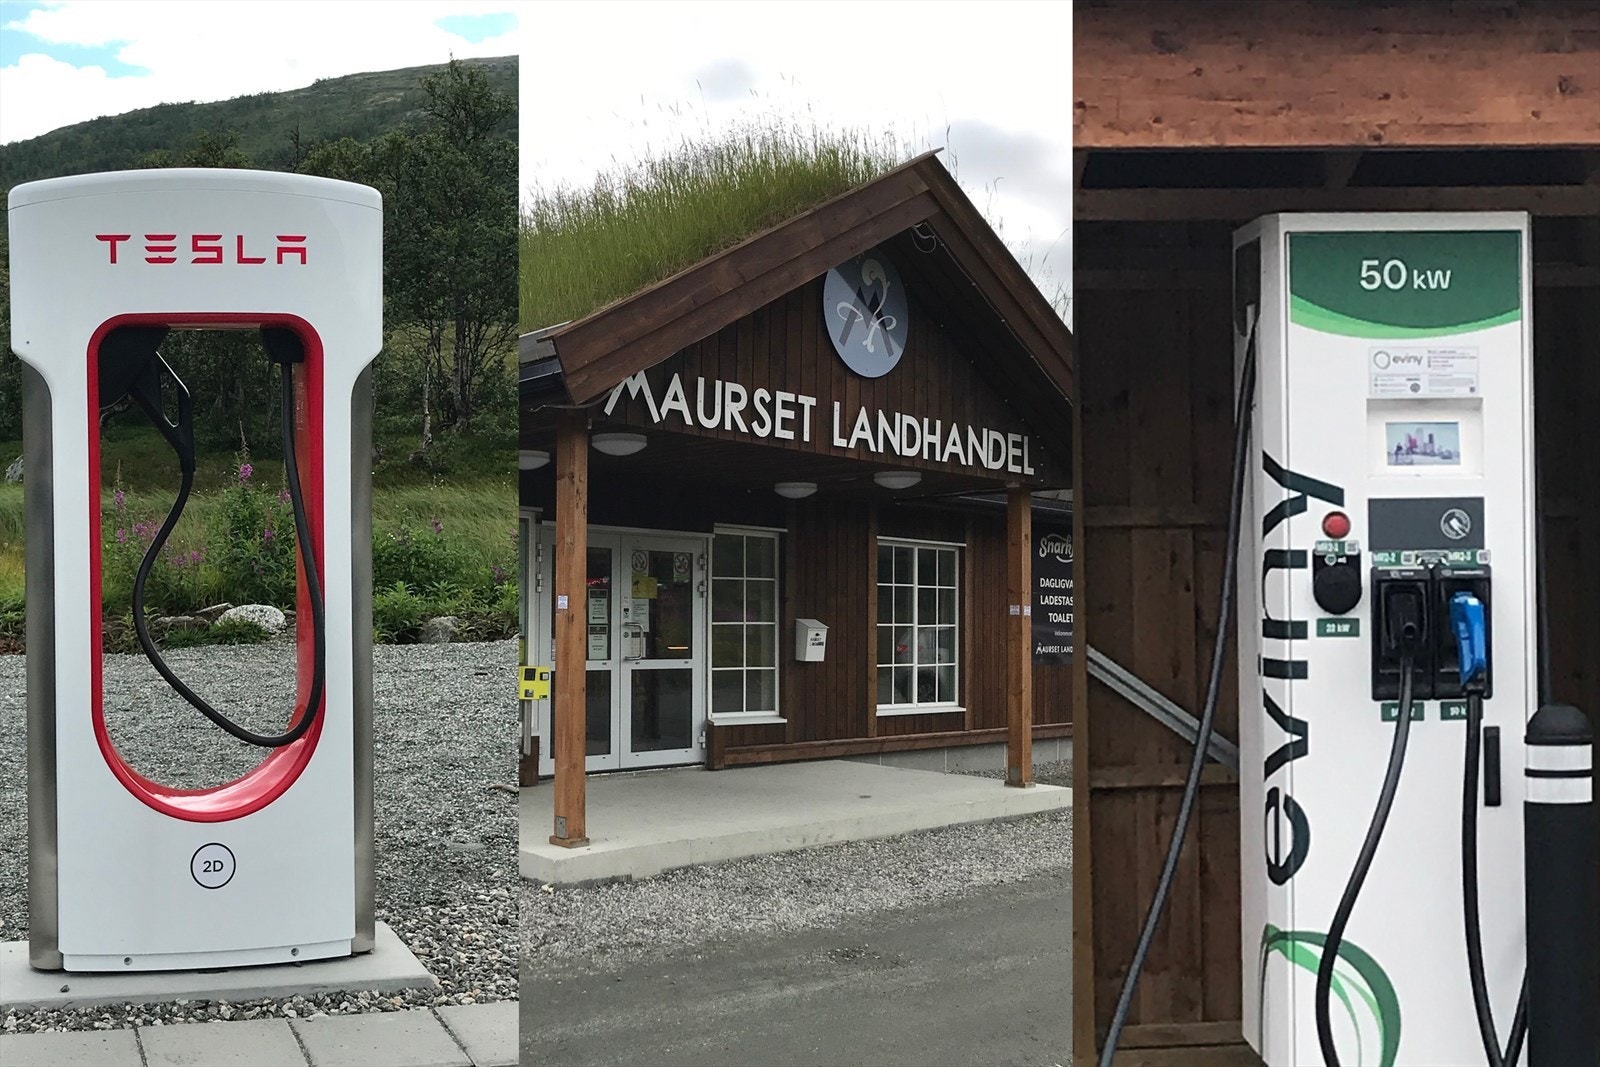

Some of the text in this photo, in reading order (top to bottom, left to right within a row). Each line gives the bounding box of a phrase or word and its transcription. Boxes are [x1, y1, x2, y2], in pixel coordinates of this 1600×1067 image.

[95, 234, 307, 265] TESLA
[1359, 259, 1452, 291] 50 kW
[1392, 354, 1423, 366] eviny
[603, 370, 1035, 476] MAURSET LANDHANDEL
[1040, 578, 1073, 589] DAGLIGVA
[1040, 595, 1073, 606] LADESTAS
[1258, 449, 1345, 887] eviny
[202, 860, 224, 873] 2D
